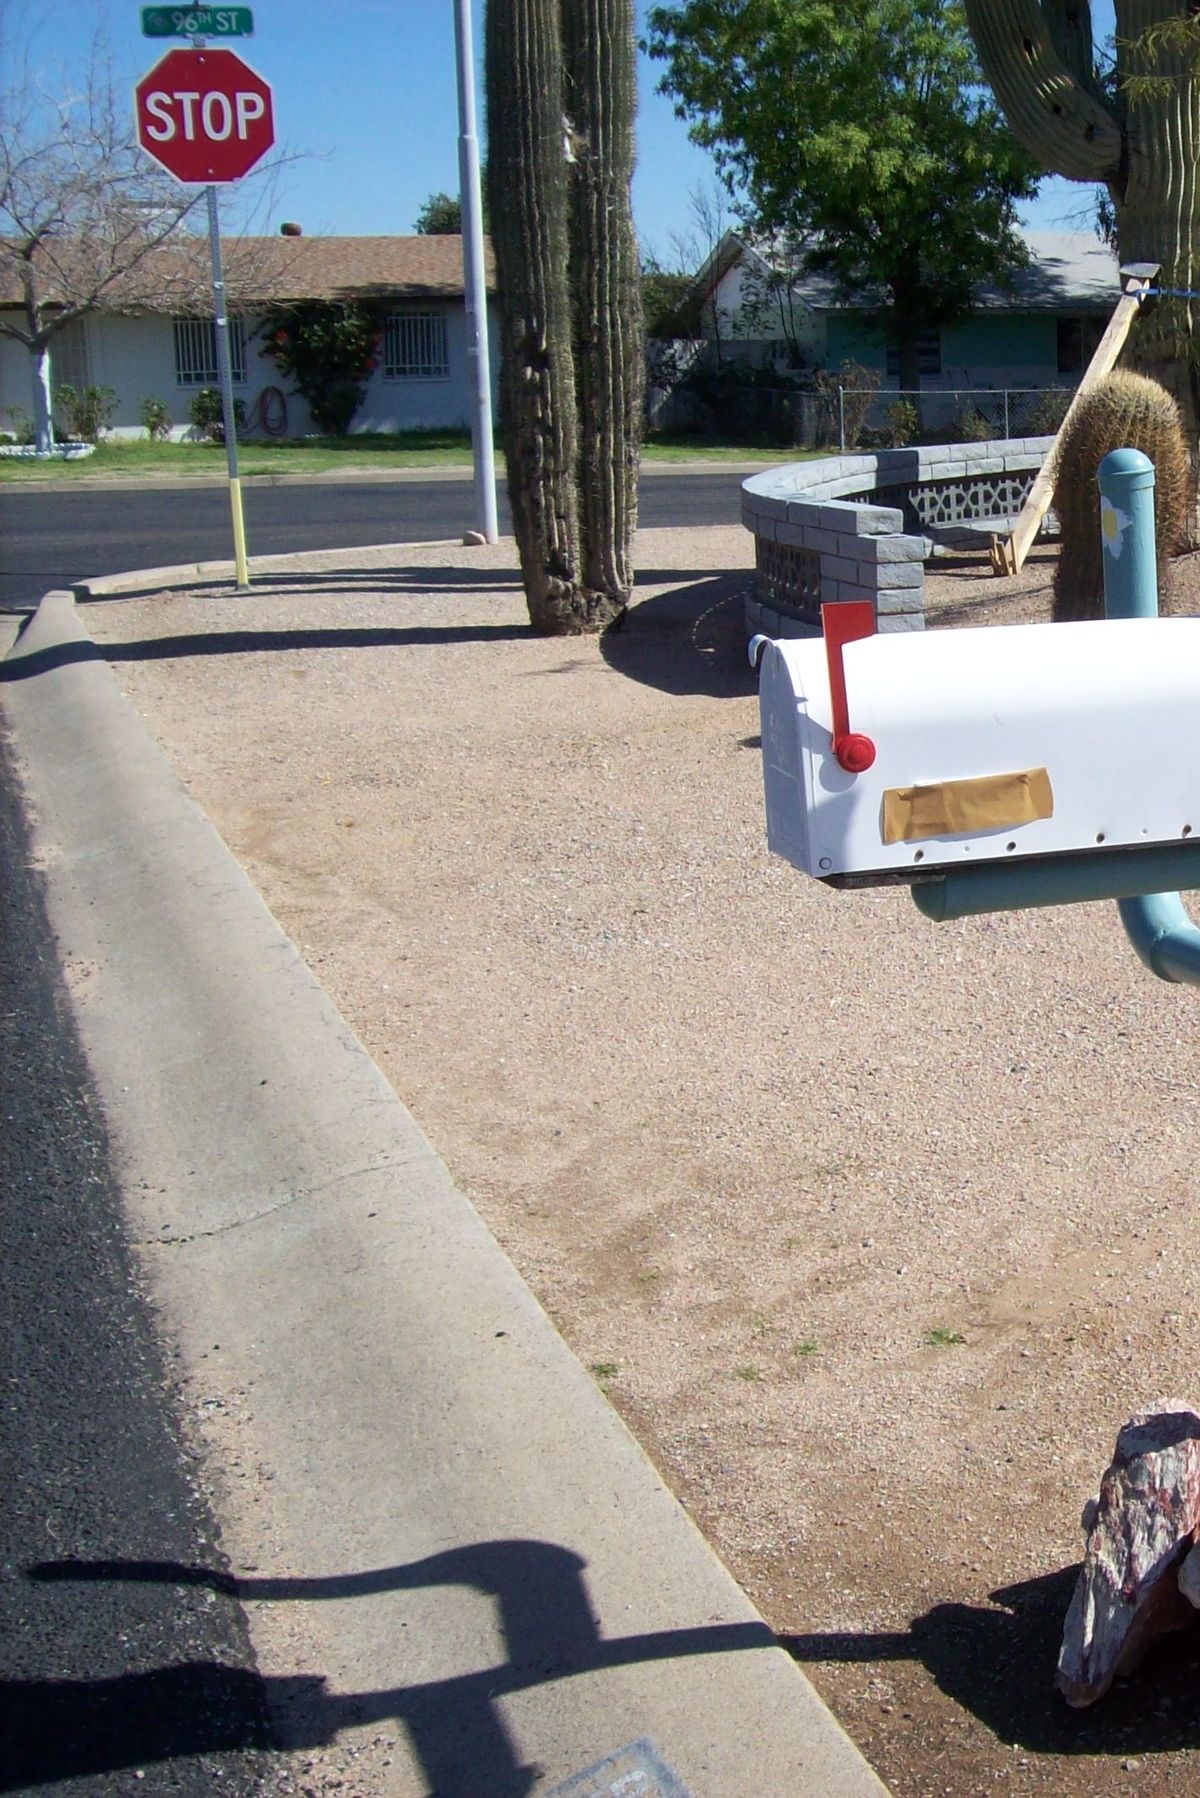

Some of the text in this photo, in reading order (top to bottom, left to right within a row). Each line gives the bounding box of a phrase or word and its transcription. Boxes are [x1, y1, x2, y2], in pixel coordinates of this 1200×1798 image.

[171, 12, 239, 32] 96TH ST
[146, 91, 265, 141] STOP
